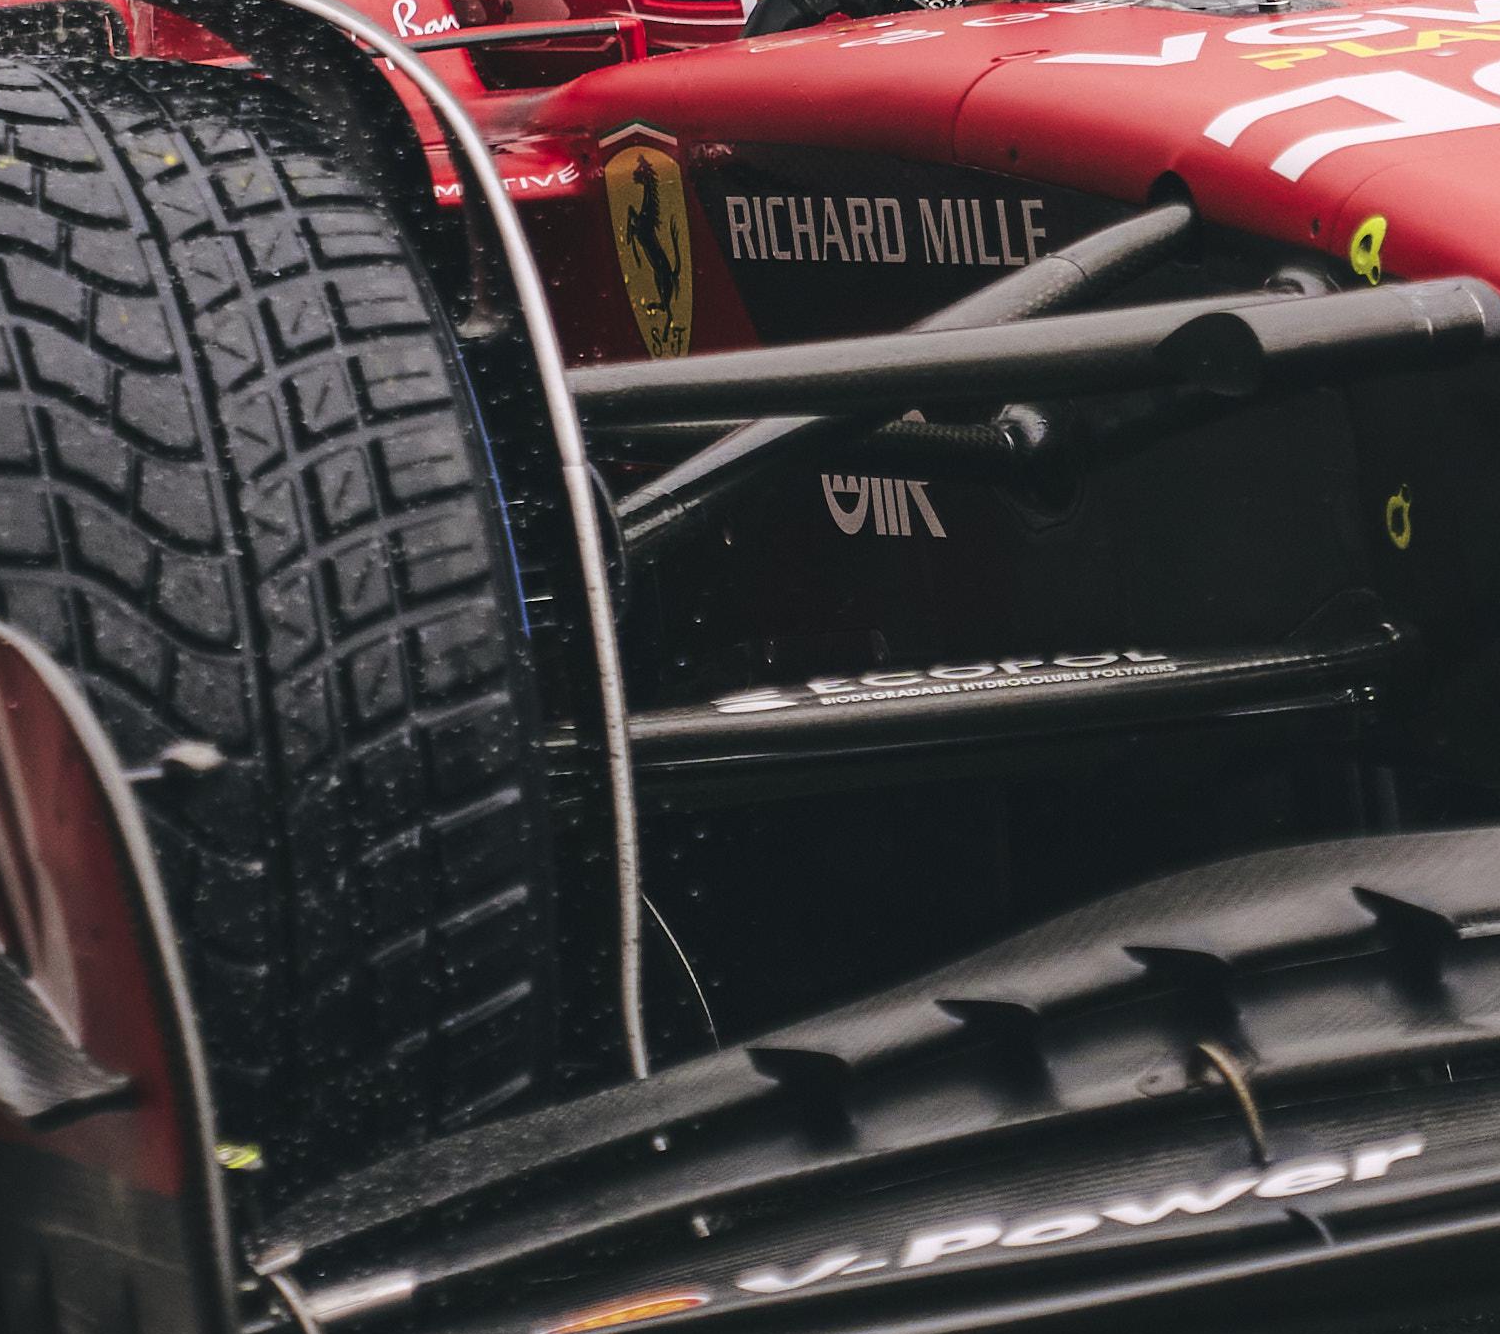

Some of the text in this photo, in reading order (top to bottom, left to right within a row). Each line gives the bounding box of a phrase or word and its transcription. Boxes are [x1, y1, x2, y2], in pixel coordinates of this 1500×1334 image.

[726, 196, 1048, 267] RICHARD MILLE
[807, 649, 1168, 695] ECOPOL
[820, 662, 1178, 707] BIODEGRADABLE HYDROSOLUBLE POLYMERS
[736, 1133, 1427, 1295] V-Power
